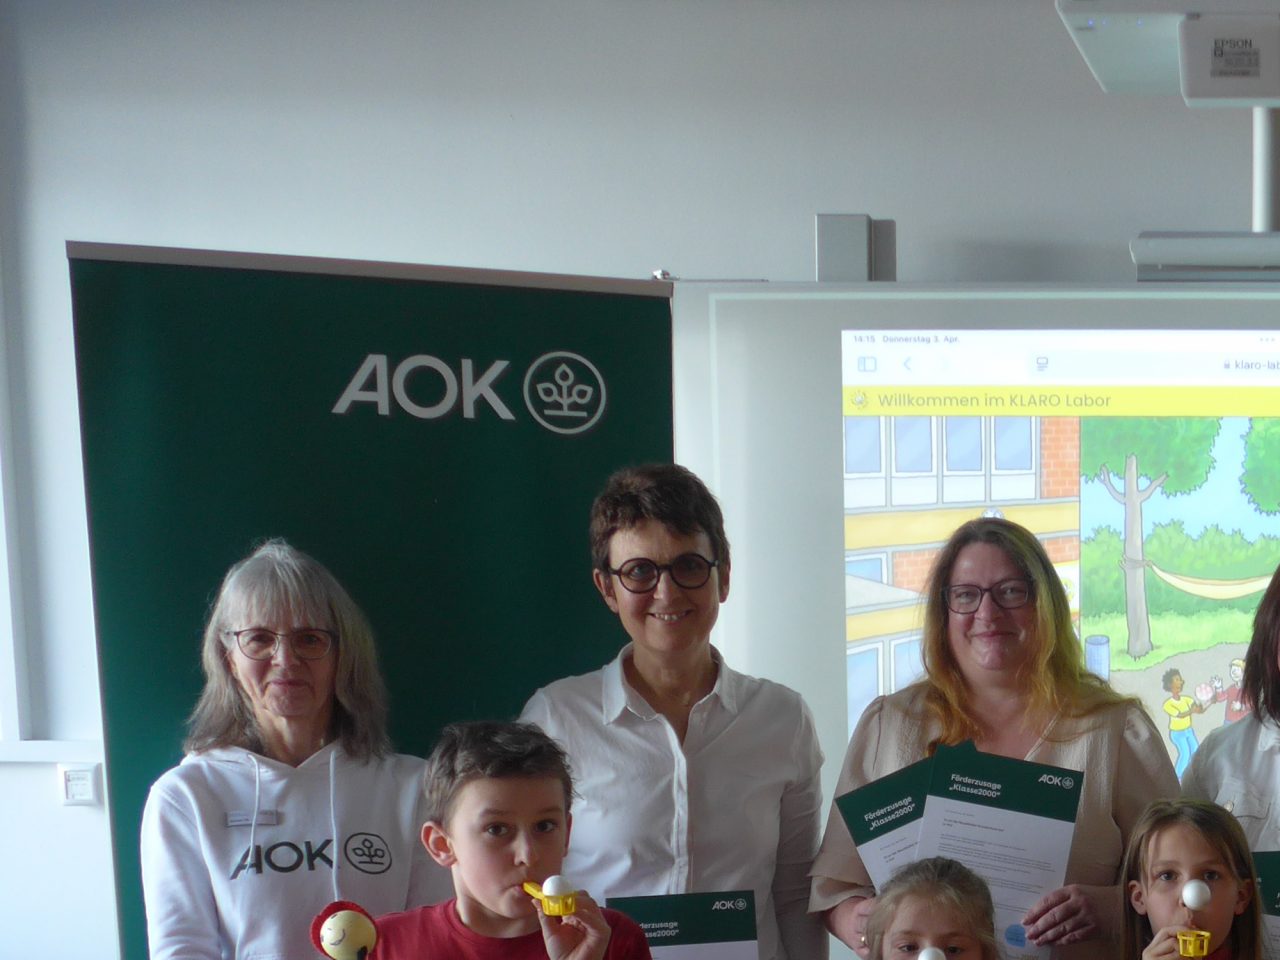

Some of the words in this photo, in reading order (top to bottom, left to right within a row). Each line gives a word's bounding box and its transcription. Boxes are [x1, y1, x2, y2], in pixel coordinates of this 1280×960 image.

[1214, 39, 1253, 49] EPSON
[331, 353, 516, 421] AOK
[878, 393, 980, 408] Willkommen
[984, 394, 1005, 408] im
[1009, 393, 1061, 408] KLARO
[1065, 393, 1111, 408] Labor
[951, 773, 1002, 790] Förderzusage
[1038, 774, 1062, 786] AOK
[864, 796, 913, 822] Förderzusage
[230, 839, 340, 880] AOK
[712, 900, 735, 911] AOK
[639, 921, 678, 930] derzusage
